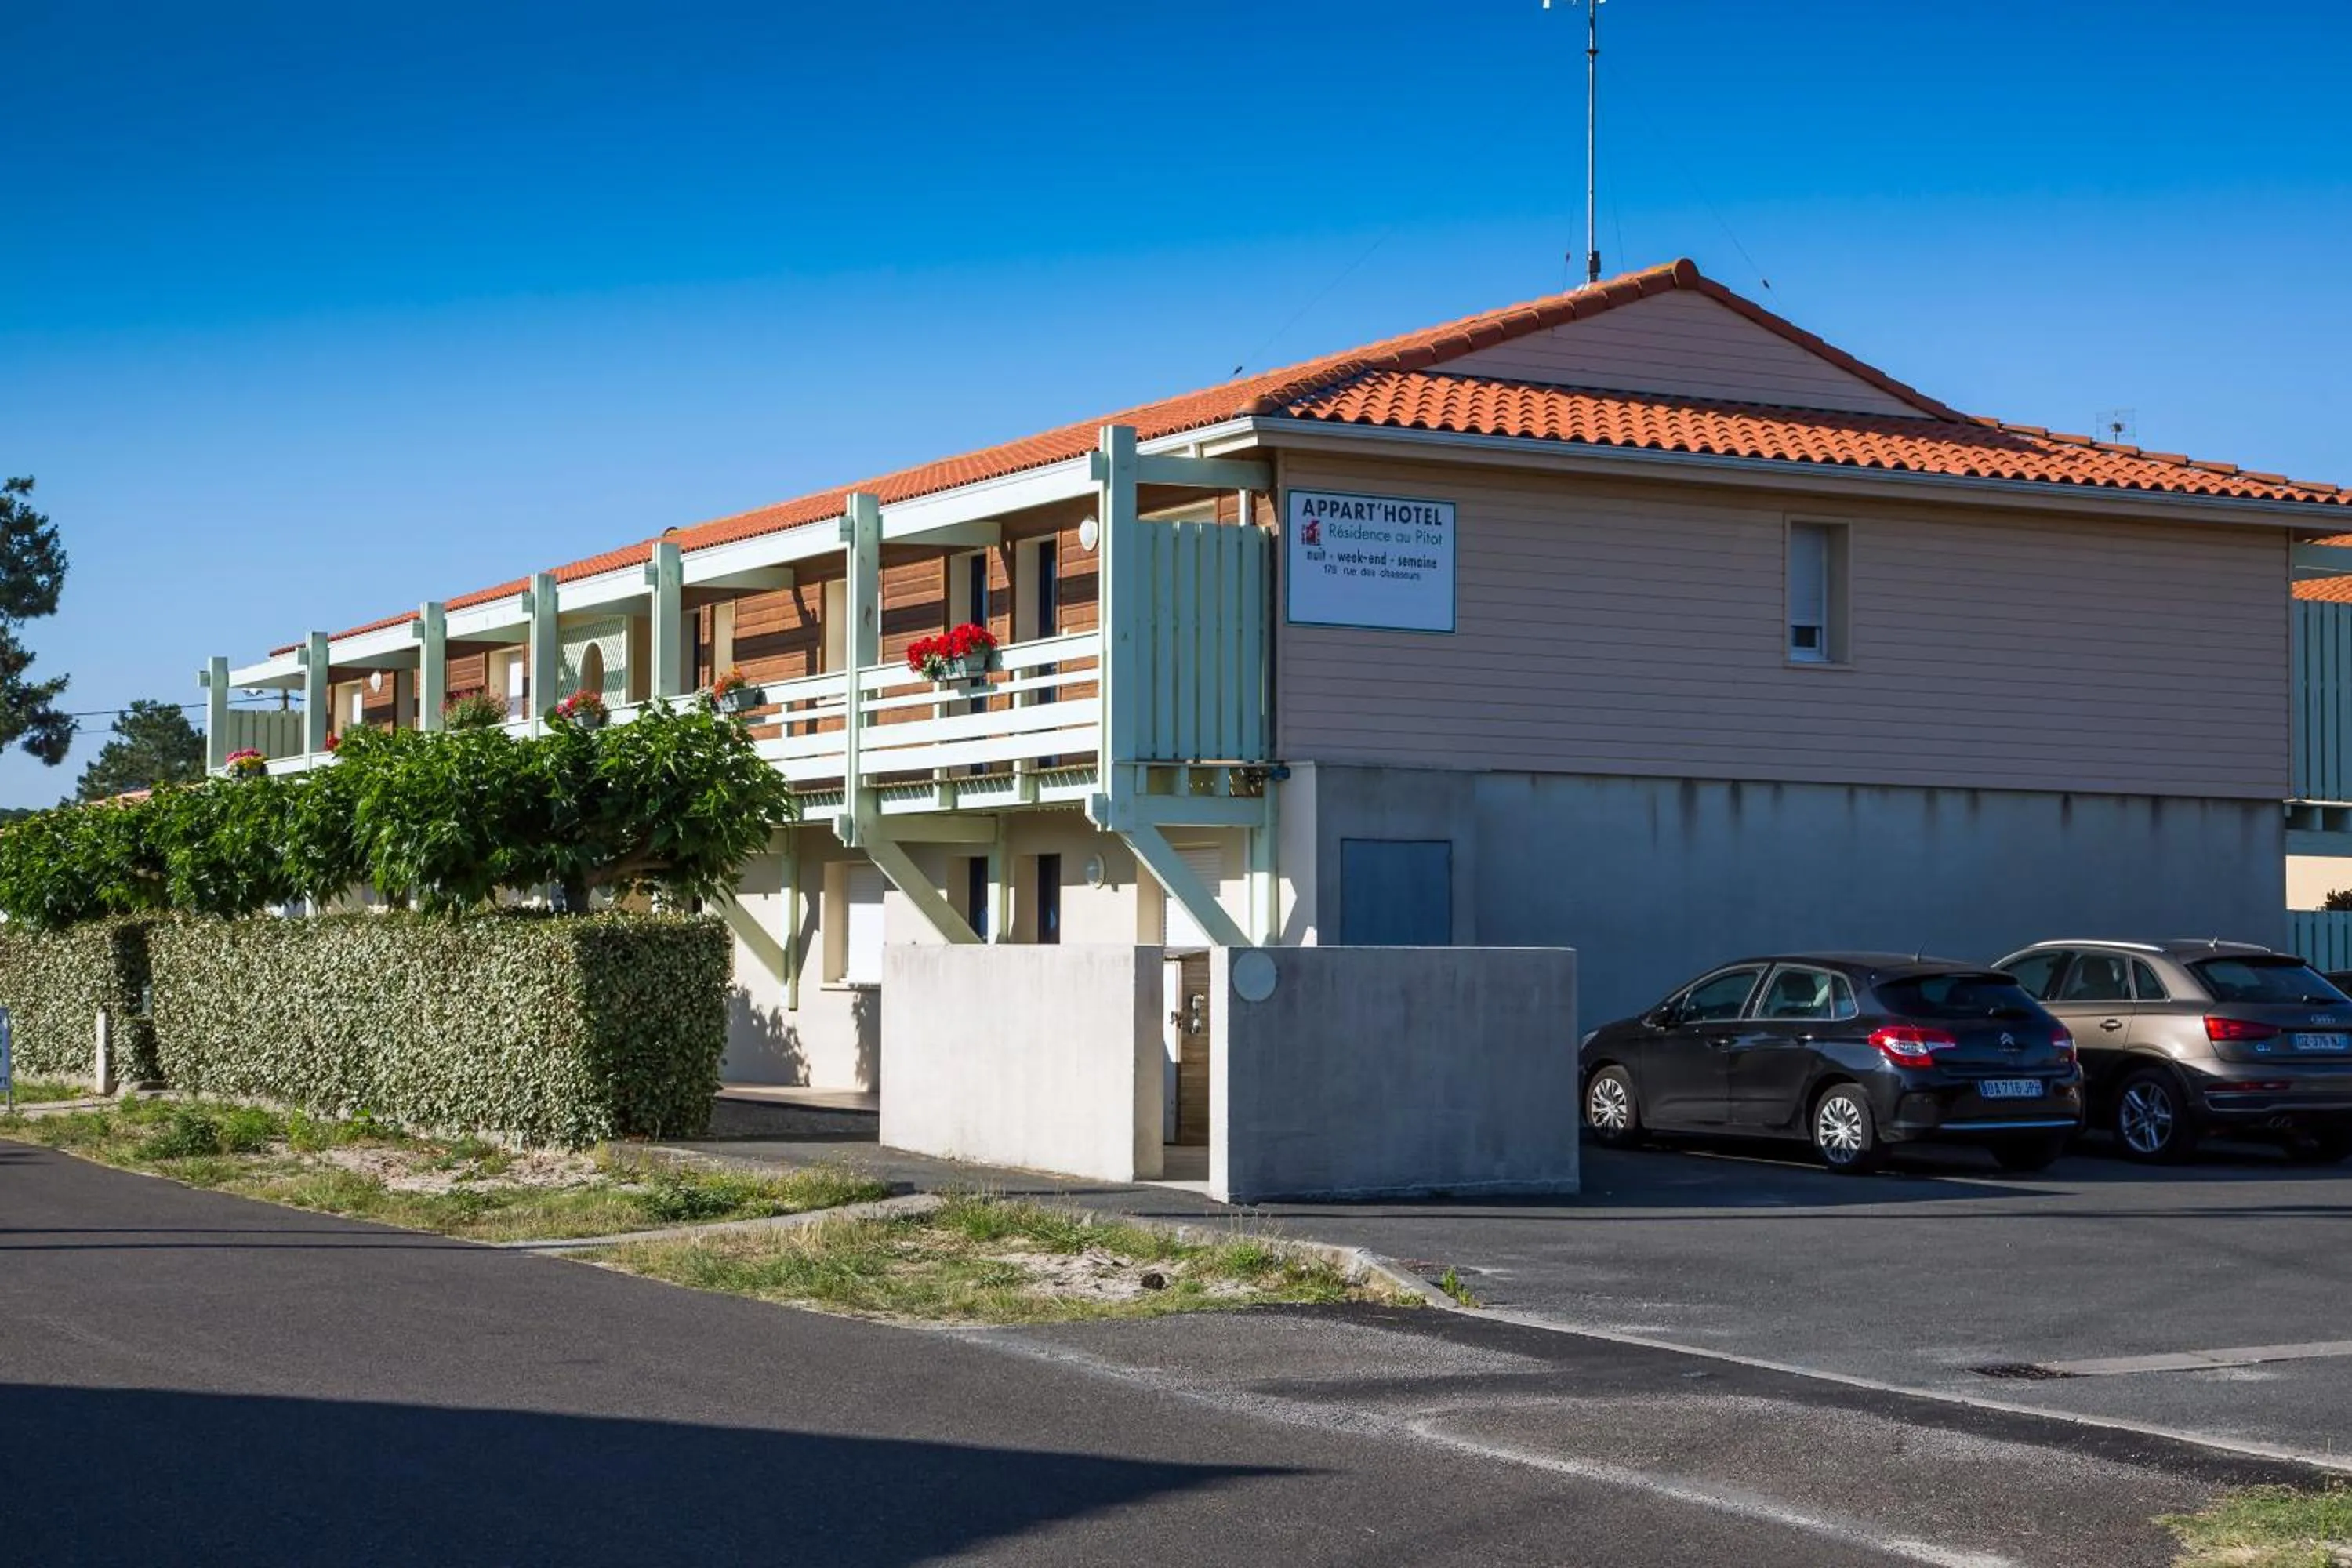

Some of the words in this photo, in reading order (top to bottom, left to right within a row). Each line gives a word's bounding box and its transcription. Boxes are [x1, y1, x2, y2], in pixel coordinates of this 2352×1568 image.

[1302, 498, 1442, 526] APPART'HOTEL
[1329, 523, 1391, 543] Résidence
[1395, 532, 1410, 543] au
[1416, 529, 1443, 546] Pitot
[1307, 547, 1326, 561] nuit
[1338, 549, 1387, 565] week-end
[1398, 554, 1438, 569] semaine
[1343, 567, 1357, 576] rue
[1360, 567, 1376, 578] des
